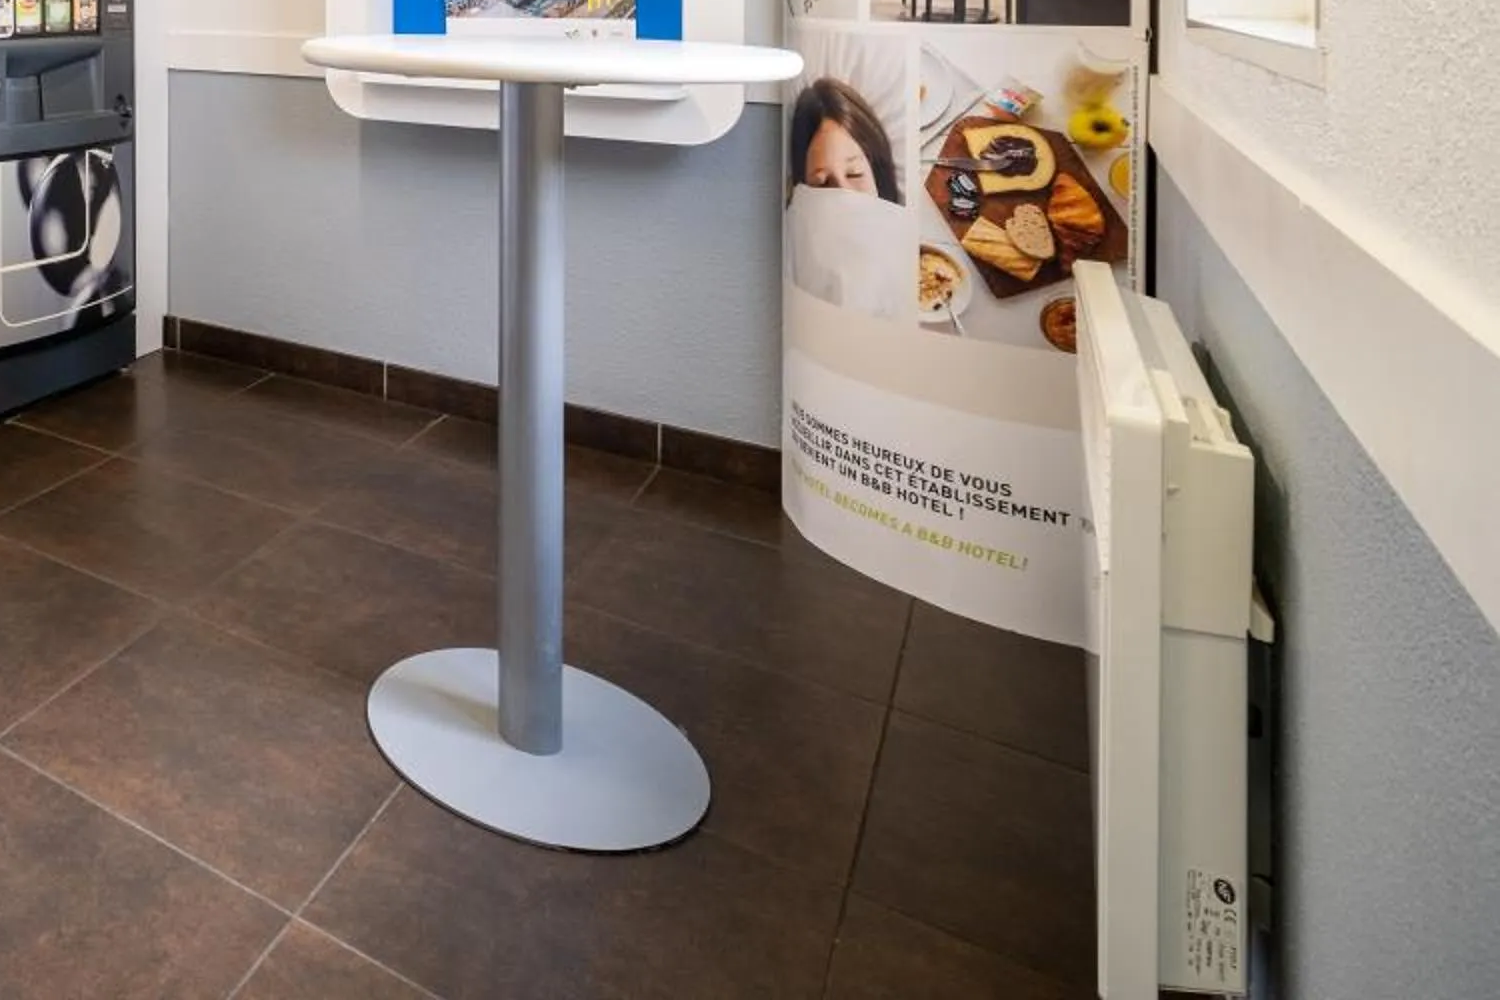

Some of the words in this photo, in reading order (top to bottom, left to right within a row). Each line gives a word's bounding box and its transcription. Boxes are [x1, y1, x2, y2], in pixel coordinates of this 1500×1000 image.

[805, 413, 849, 445] SOMMES
[851, 438, 925, 474] HEUREUX
[930, 465, 954, 483] DE
[959, 471, 1012, 497] VOUS
[835, 445, 871, 471] DANS
[874, 463, 904, 482] CET
[908, 471, 1071, 526] ÉTABLISSEMENT
[839, 462, 857, 481] UN
[861, 472, 891, 495] B&B
[897, 487, 953, 517] HOTEL
[901, 522, 913, 536] A
[917, 527, 954, 549] B&B
